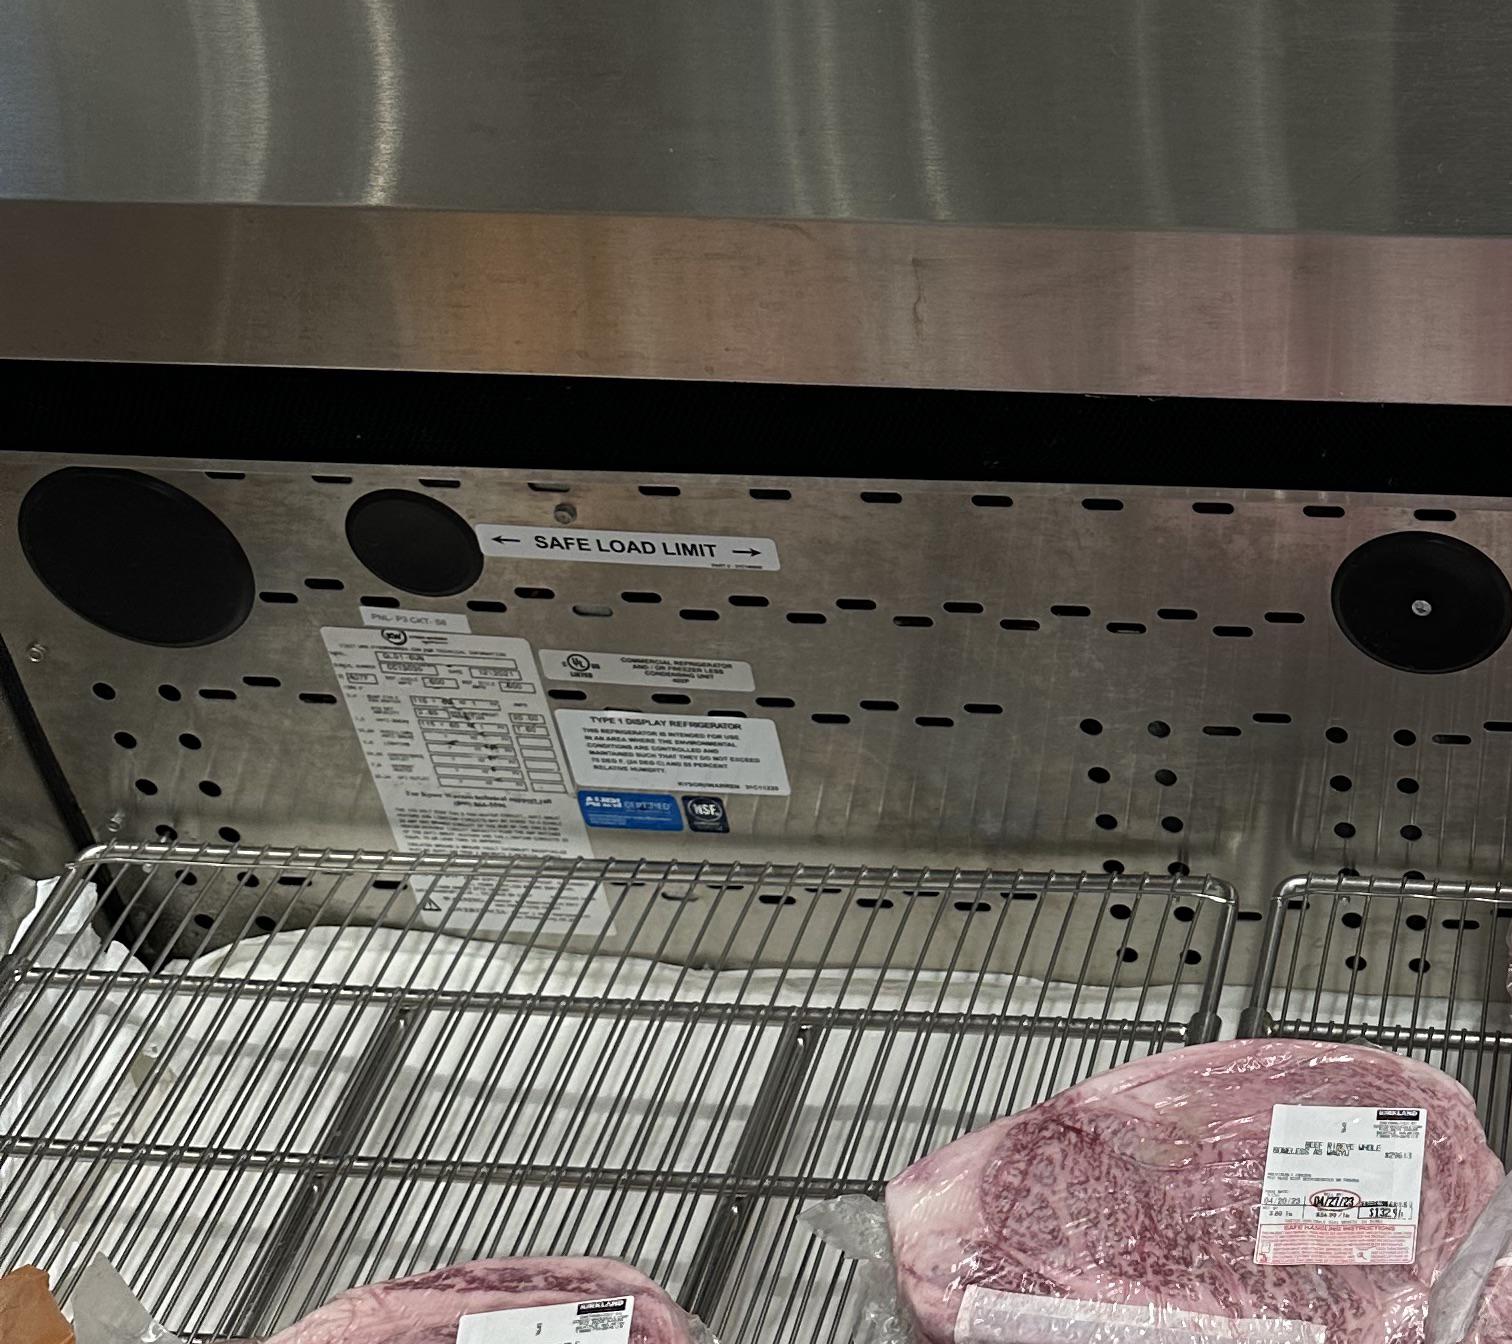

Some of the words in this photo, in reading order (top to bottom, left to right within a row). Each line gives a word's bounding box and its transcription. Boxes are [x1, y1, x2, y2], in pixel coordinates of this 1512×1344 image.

[534, 535, 592, 553] SAFE
[597, 538, 656, 556] LOAD
[663, 541, 717, 558] LIMIT
[590, 716, 616, 724] TYPE
[626, 719, 667, 727] DISPLAY
[670, 721, 742, 730] REFRIGERATOR
[1313, 1196, 1354, 1207] 04/27/23
